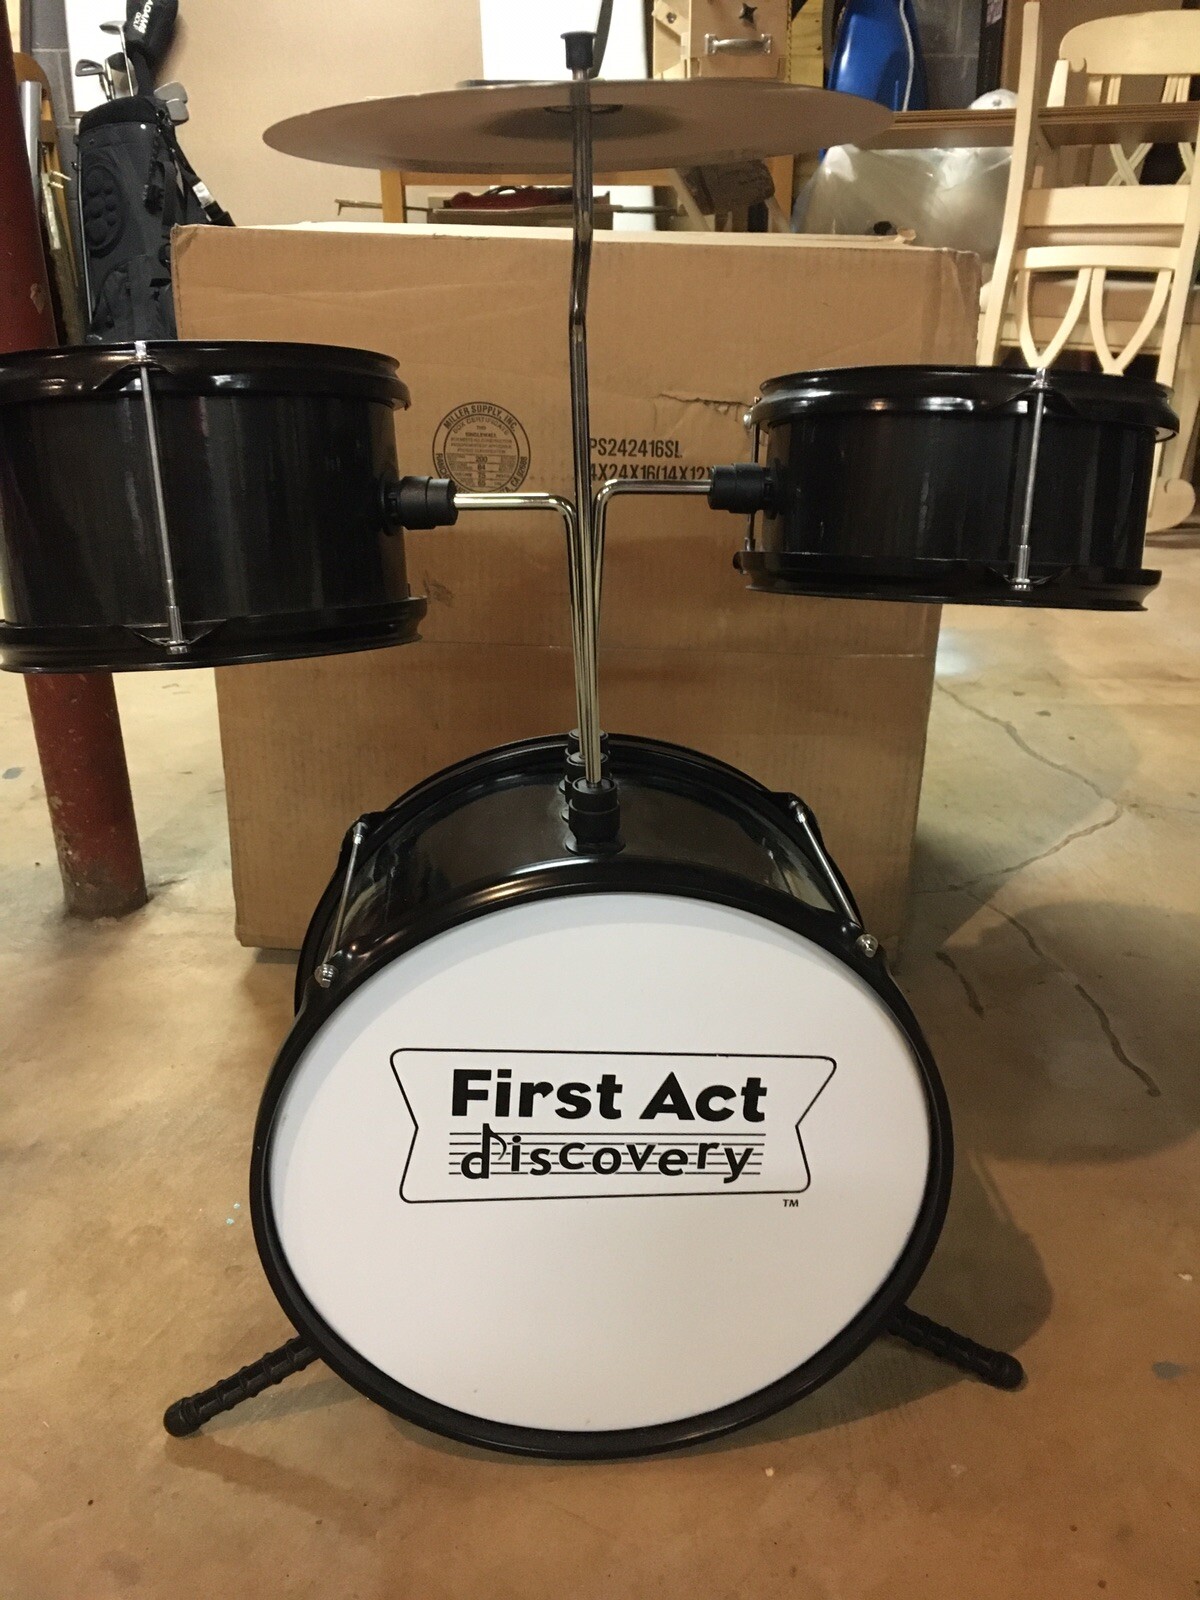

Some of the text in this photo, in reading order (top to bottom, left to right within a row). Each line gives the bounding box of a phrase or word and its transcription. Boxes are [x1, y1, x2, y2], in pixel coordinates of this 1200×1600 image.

[443, 405, 518, 432] MILLER SUPPLY, INC.
[452, 416, 509, 436] BOX CERTIFICATE
[510, 477, 521, 487] CA
[450, 1068, 768, 1123] First Act
[460, 1123, 754, 1184] discovery
[782, 1199, 799, 1208] TM
